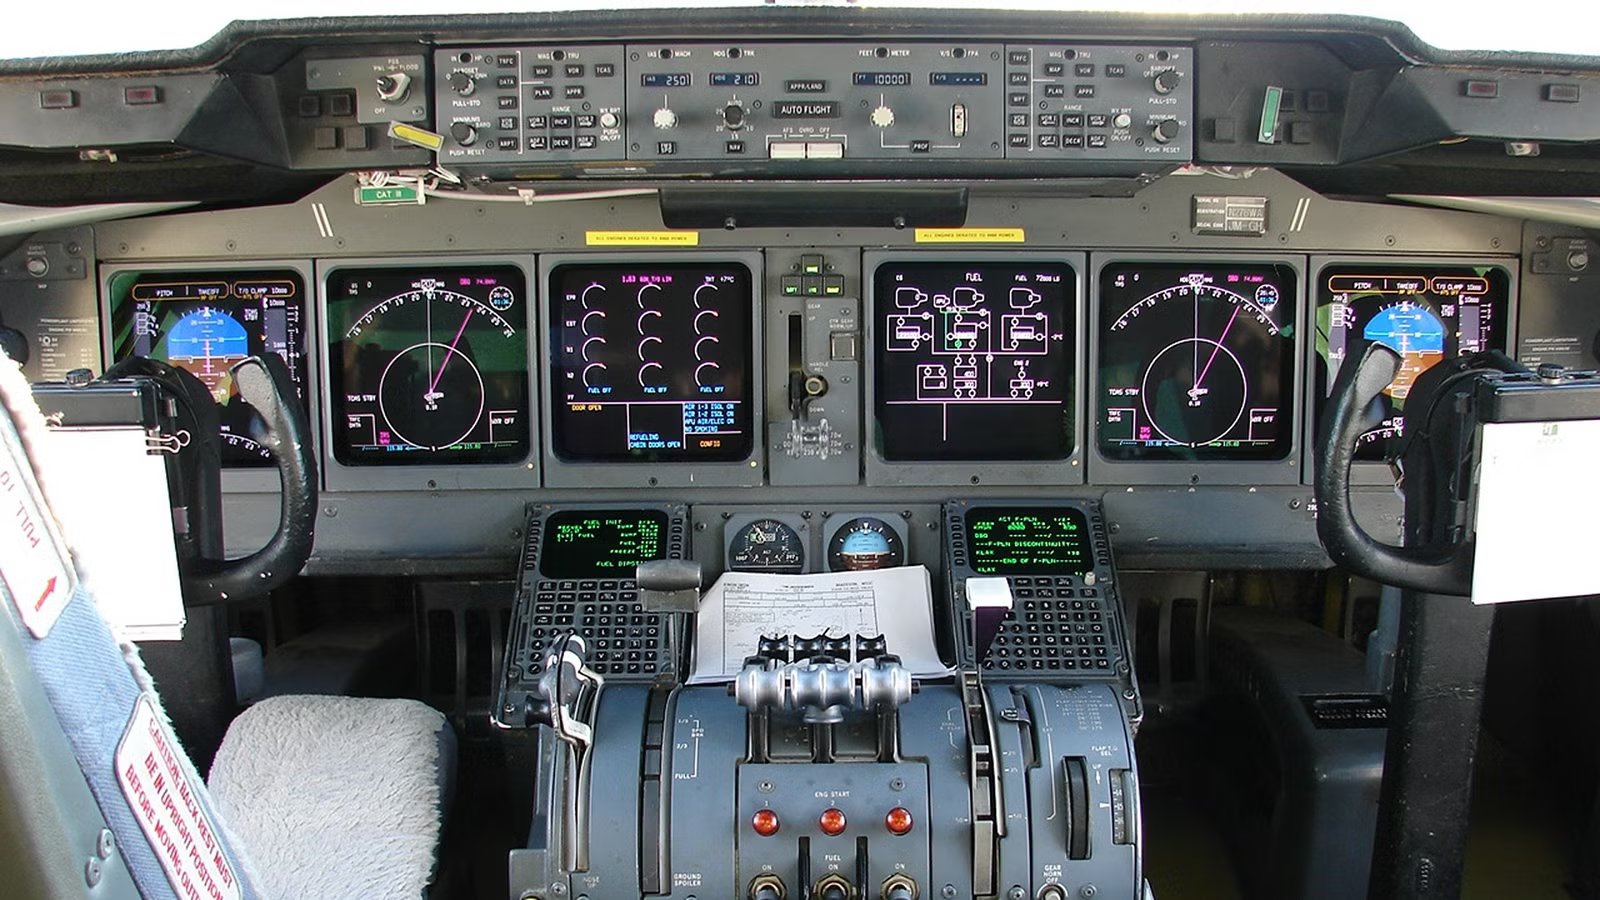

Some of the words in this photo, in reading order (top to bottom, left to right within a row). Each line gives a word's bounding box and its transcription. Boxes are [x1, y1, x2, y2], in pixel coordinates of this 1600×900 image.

[875, 75, 905, 85] 10000
[781, 105, 803, 113] AUTO
[804, 105, 831, 113] FLIGHT
[966, 273, 983, 281] FUEL
[1163, 291, 1172, 300] 19
[1146, 298, 1156, 307] 18
[477, 306, 486, 315] 24
[1131, 309, 1140, 317] 17
[366, 315, 374, 324] 17
[16, 500, 41, 549] PULL
[144, 752, 159, 780] BE
[153, 773, 166, 795] IN
[160, 788, 193, 849] UPRIGHT
[125, 763, 156, 825] BEFORE
[154, 819, 182, 876] MOVING
[180, 781, 199, 823] BACK
[197, 817, 216, 854] REST
[213, 848, 233, 889] MUST
